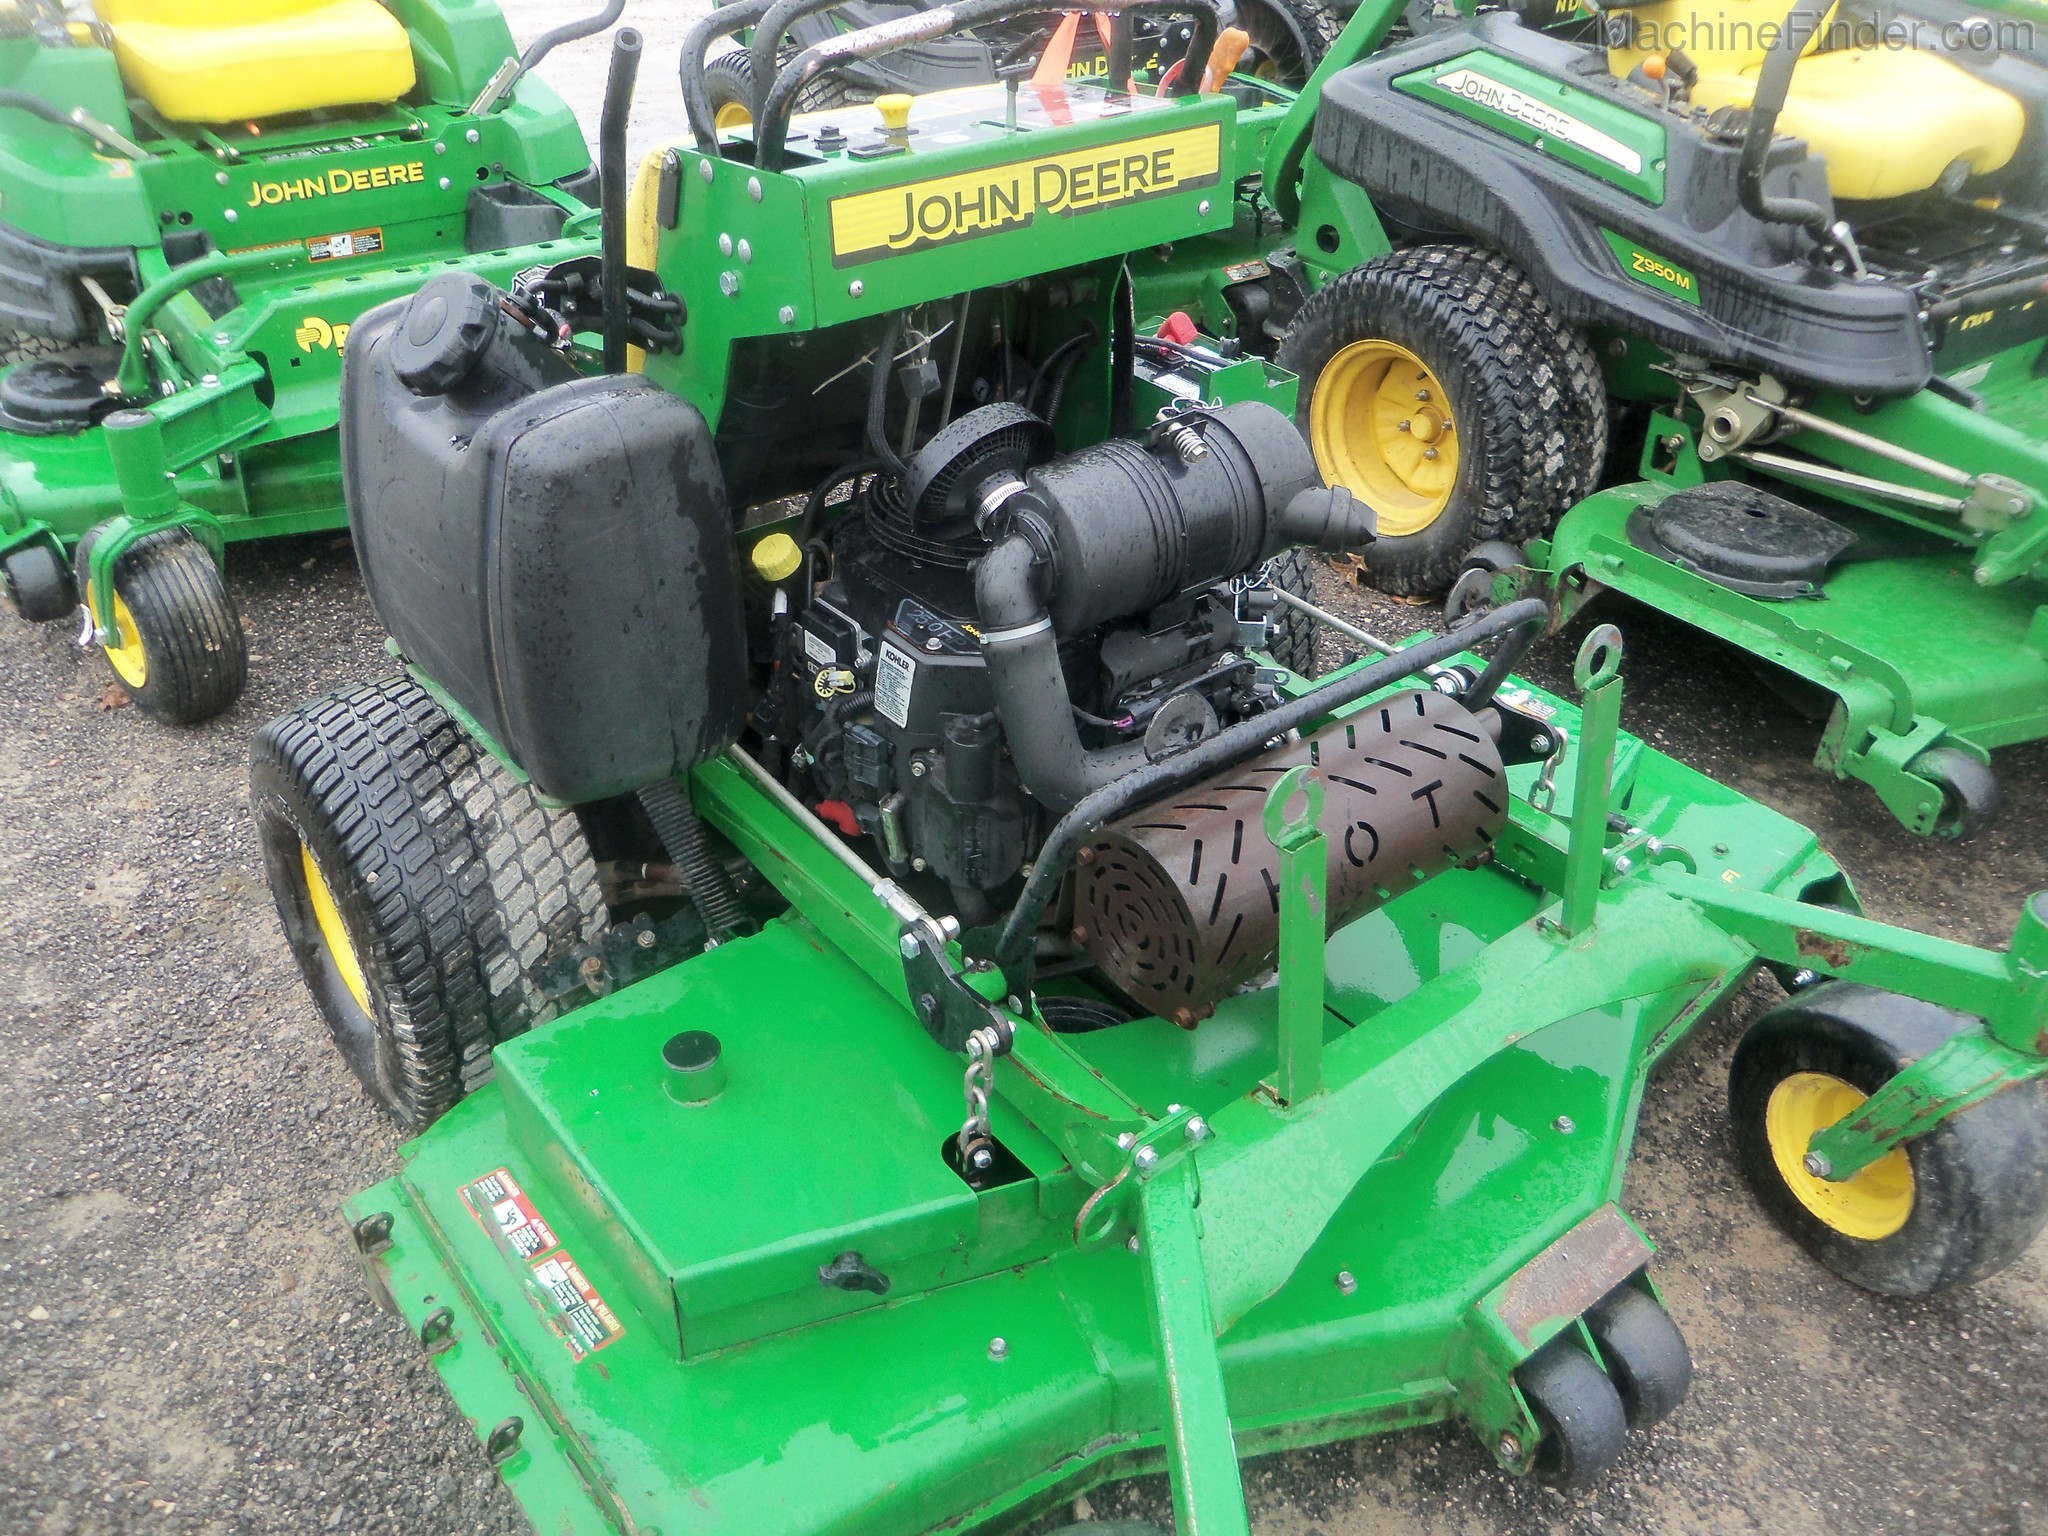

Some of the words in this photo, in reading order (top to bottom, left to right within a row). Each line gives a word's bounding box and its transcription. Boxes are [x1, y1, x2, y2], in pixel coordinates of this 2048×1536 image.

[1454, 74, 1505, 106] JOHN
[247, 176, 327, 207] JOHN
[327, 161, 425, 194] DEERE
[889, 180, 1020, 243] JOHN
[1034, 148, 1175, 204] DEERE
[1632, 252, 1690, 290] Z950M
[885, 649, 910, 671] KOHLER
[595, 1304, 620, 1331] PELIGRO
